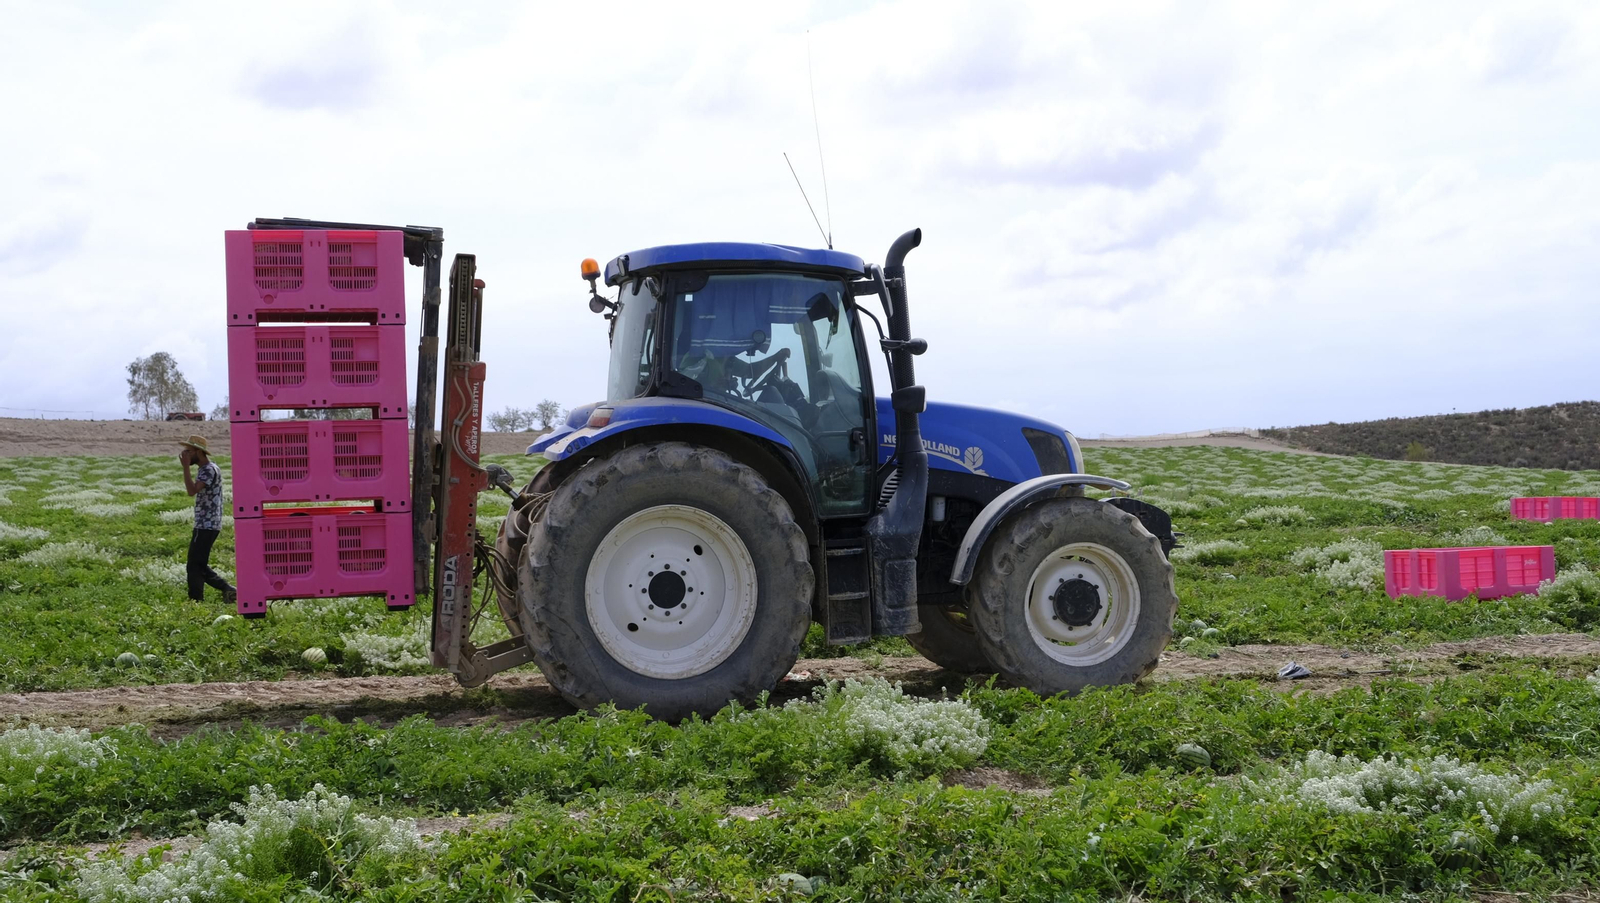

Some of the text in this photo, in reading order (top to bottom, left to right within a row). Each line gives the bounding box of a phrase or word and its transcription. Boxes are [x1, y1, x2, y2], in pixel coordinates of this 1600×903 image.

[883, 434, 961, 457] NE OLLAND
[441, 555, 458, 615] RODA
